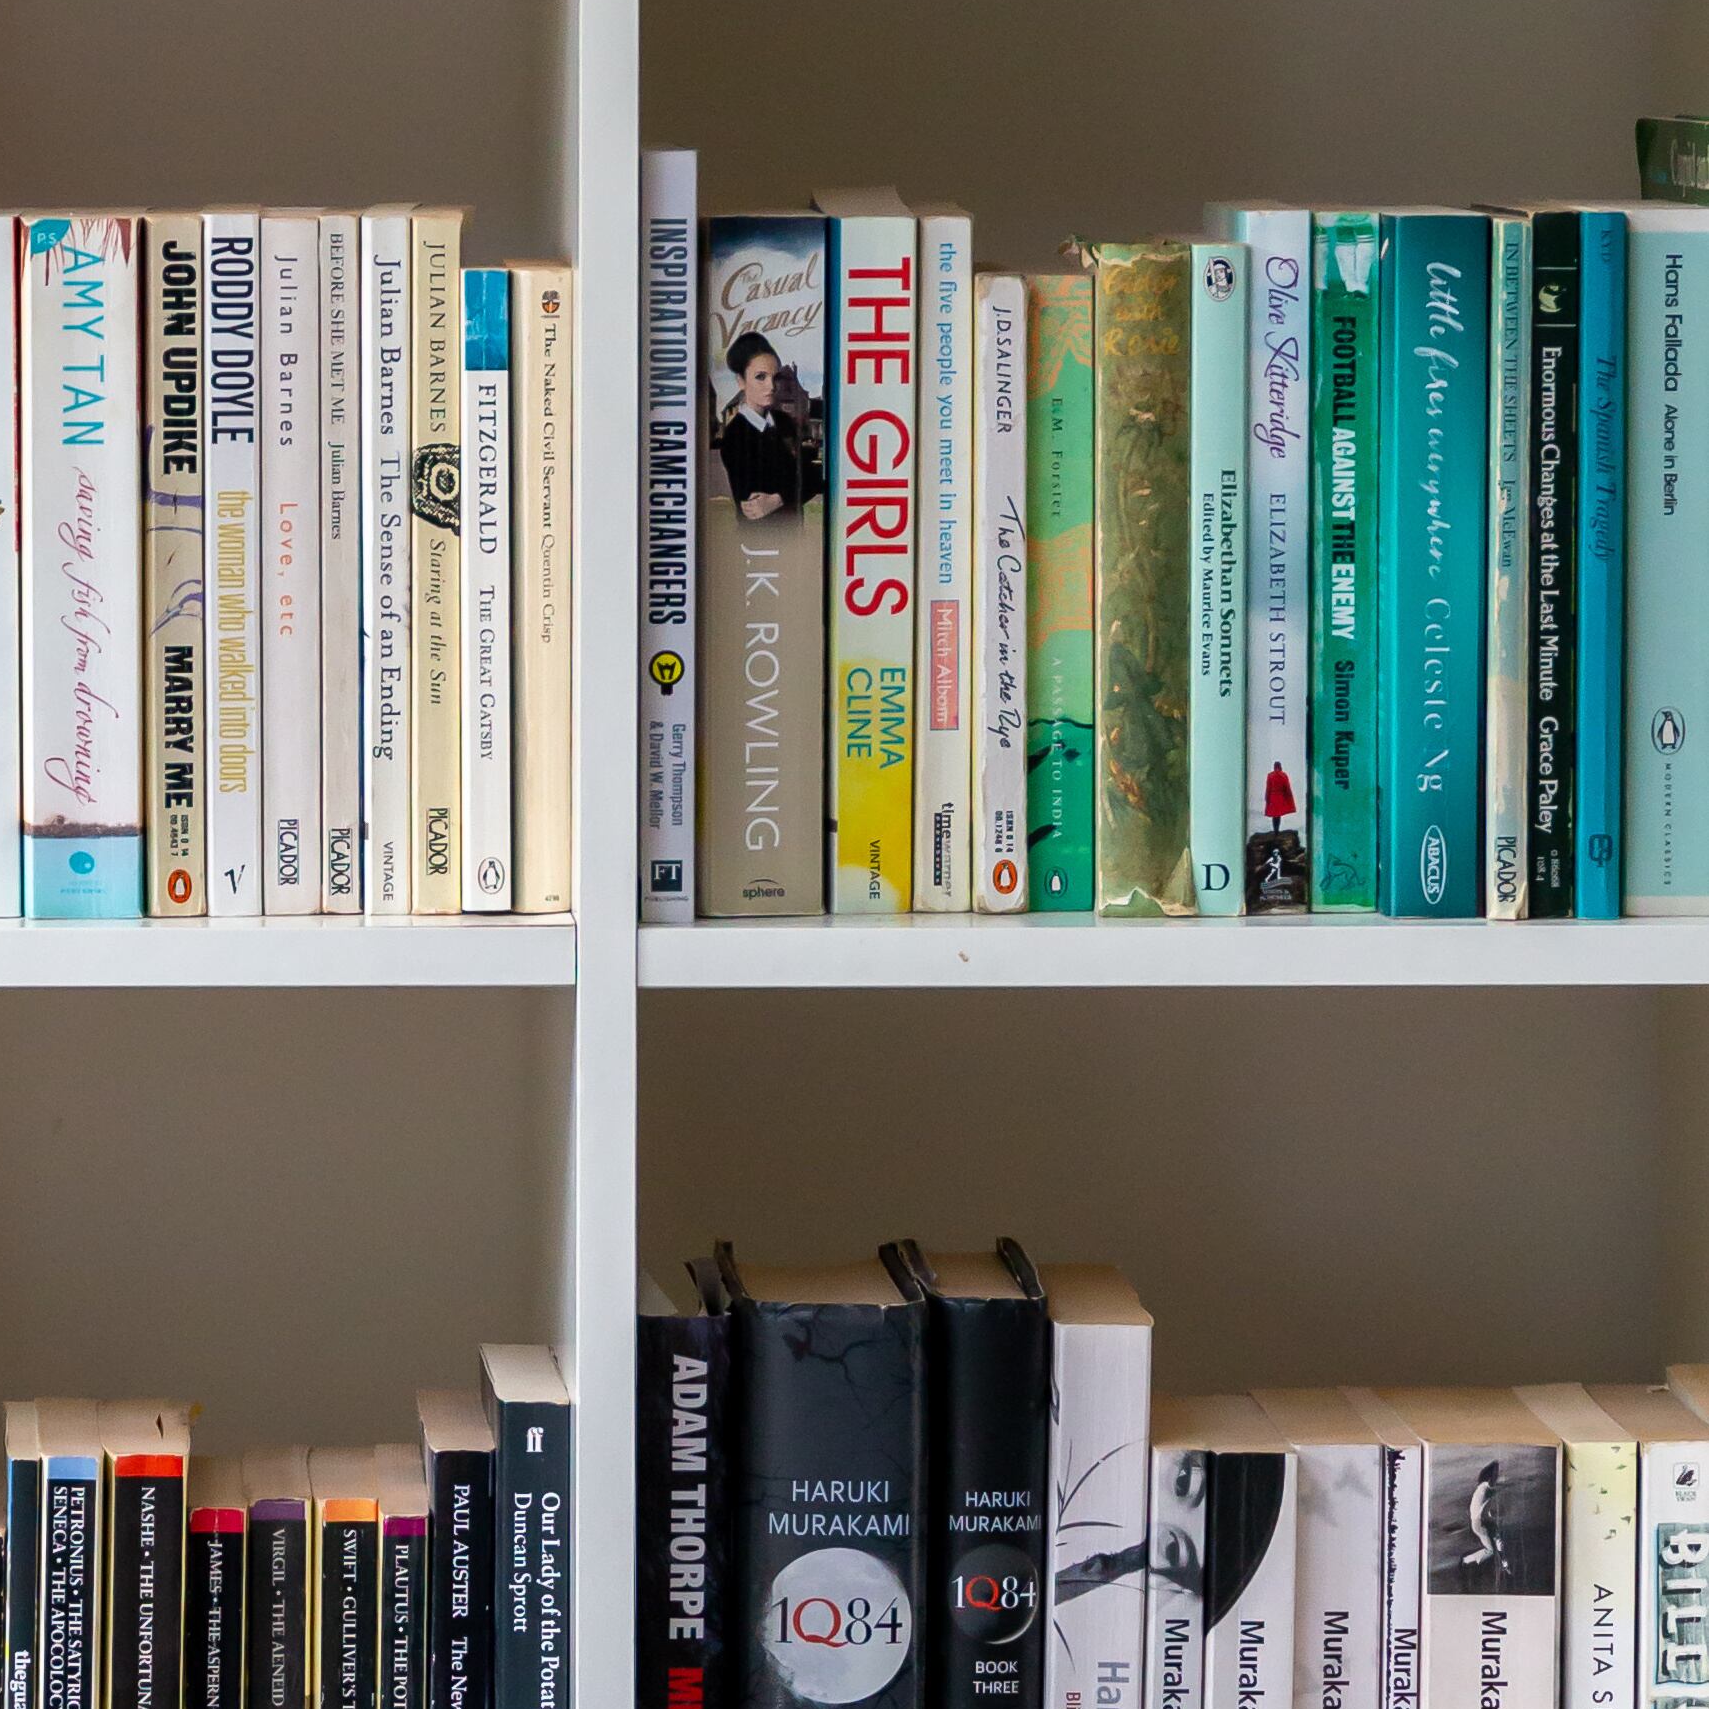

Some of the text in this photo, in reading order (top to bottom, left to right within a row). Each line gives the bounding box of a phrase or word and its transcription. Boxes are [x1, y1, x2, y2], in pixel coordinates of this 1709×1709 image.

[1663, 254, 1683, 516] Hans Fallada Alone in Berlin
[539, 324, 557, 643] The Naked Civil Servant Quentin Crisp
[843, 257, 910, 617] THE GIRLS
[371, 256, 402, 760] Julian Barnes The Sense of an Ending
[1199, 492, 1214, 676] Edited by Maurice Evans
[1219, 469, 1237, 698] Elizabethan Sonnets
[847, 667, 872, 757] CLINE
[878, 667, 905, 769] EMMA
[382, 841, 394, 901] VINTAGE
[868, 840, 882, 900] VINTAGE
[451, 1485, 469, 1535] PAUL
[769, 1512, 909, 1535] MURAKAMI
[792, 1480, 890, 1502] HARUKI
[451, 1540, 469, 1618] AUSTER
[510, 1492, 532, 1633] Duncan Sprott
[449, 1637, 467, 1670] The
[1592, 1584, 1613, 1679] ANITA
